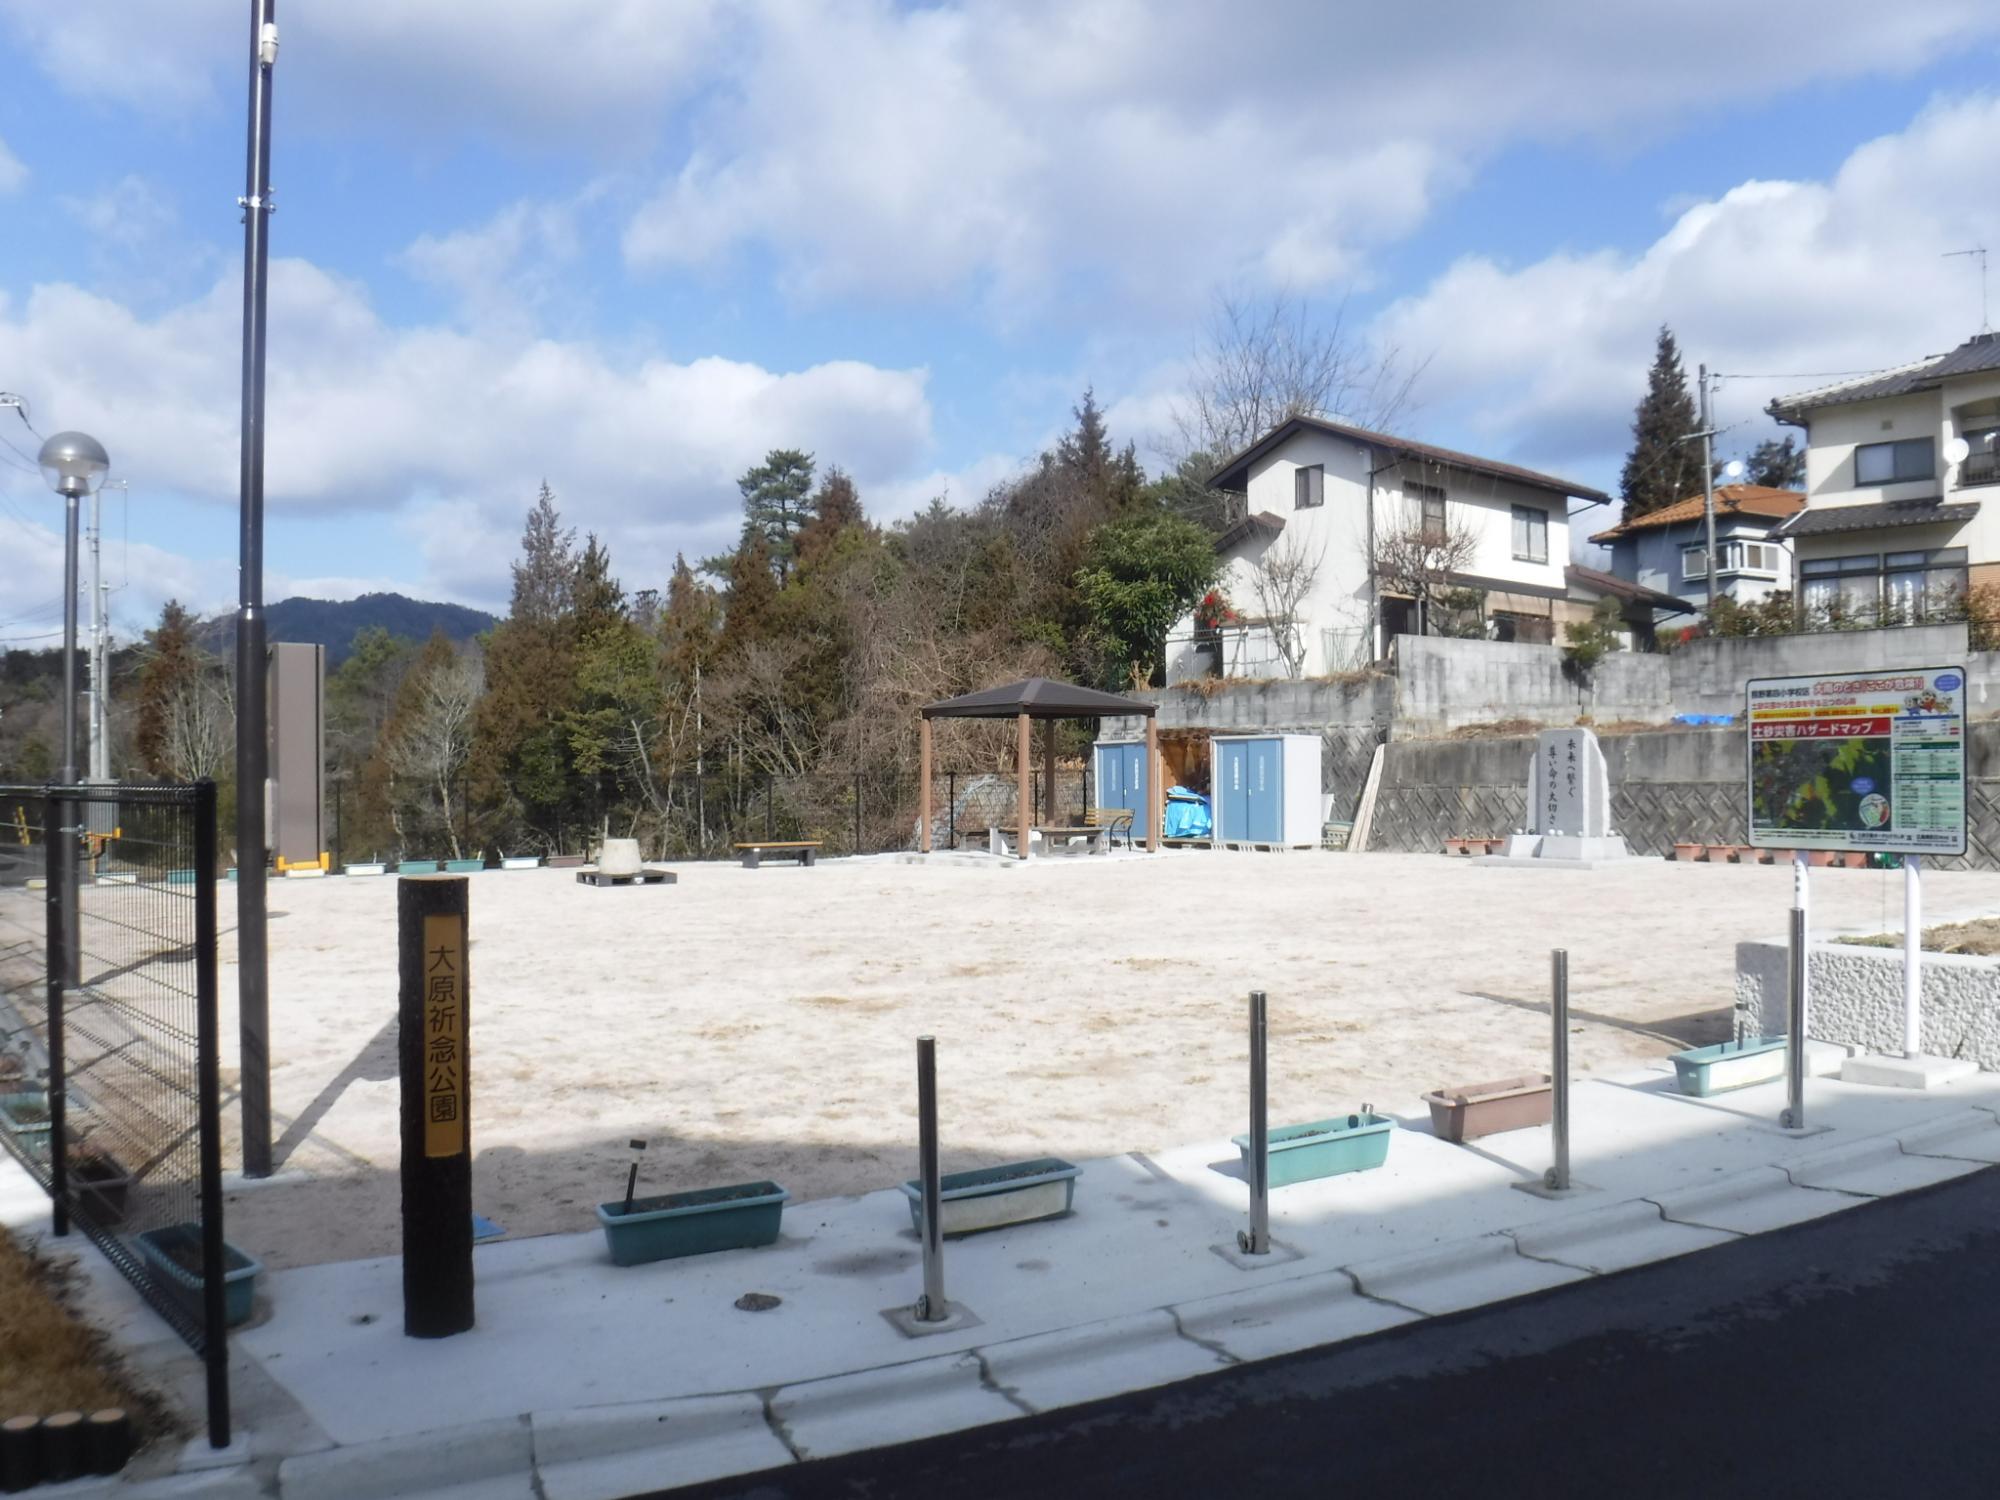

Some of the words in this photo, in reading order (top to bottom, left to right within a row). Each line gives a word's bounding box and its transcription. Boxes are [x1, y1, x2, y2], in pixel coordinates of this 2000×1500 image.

[1753, 722, 1873, 738] 土砂災害ハザードマップ
[1547, 744, 1558, 825] 尊い命の大切さ
[428, 945, 457, 1123] 大原祈念公園
